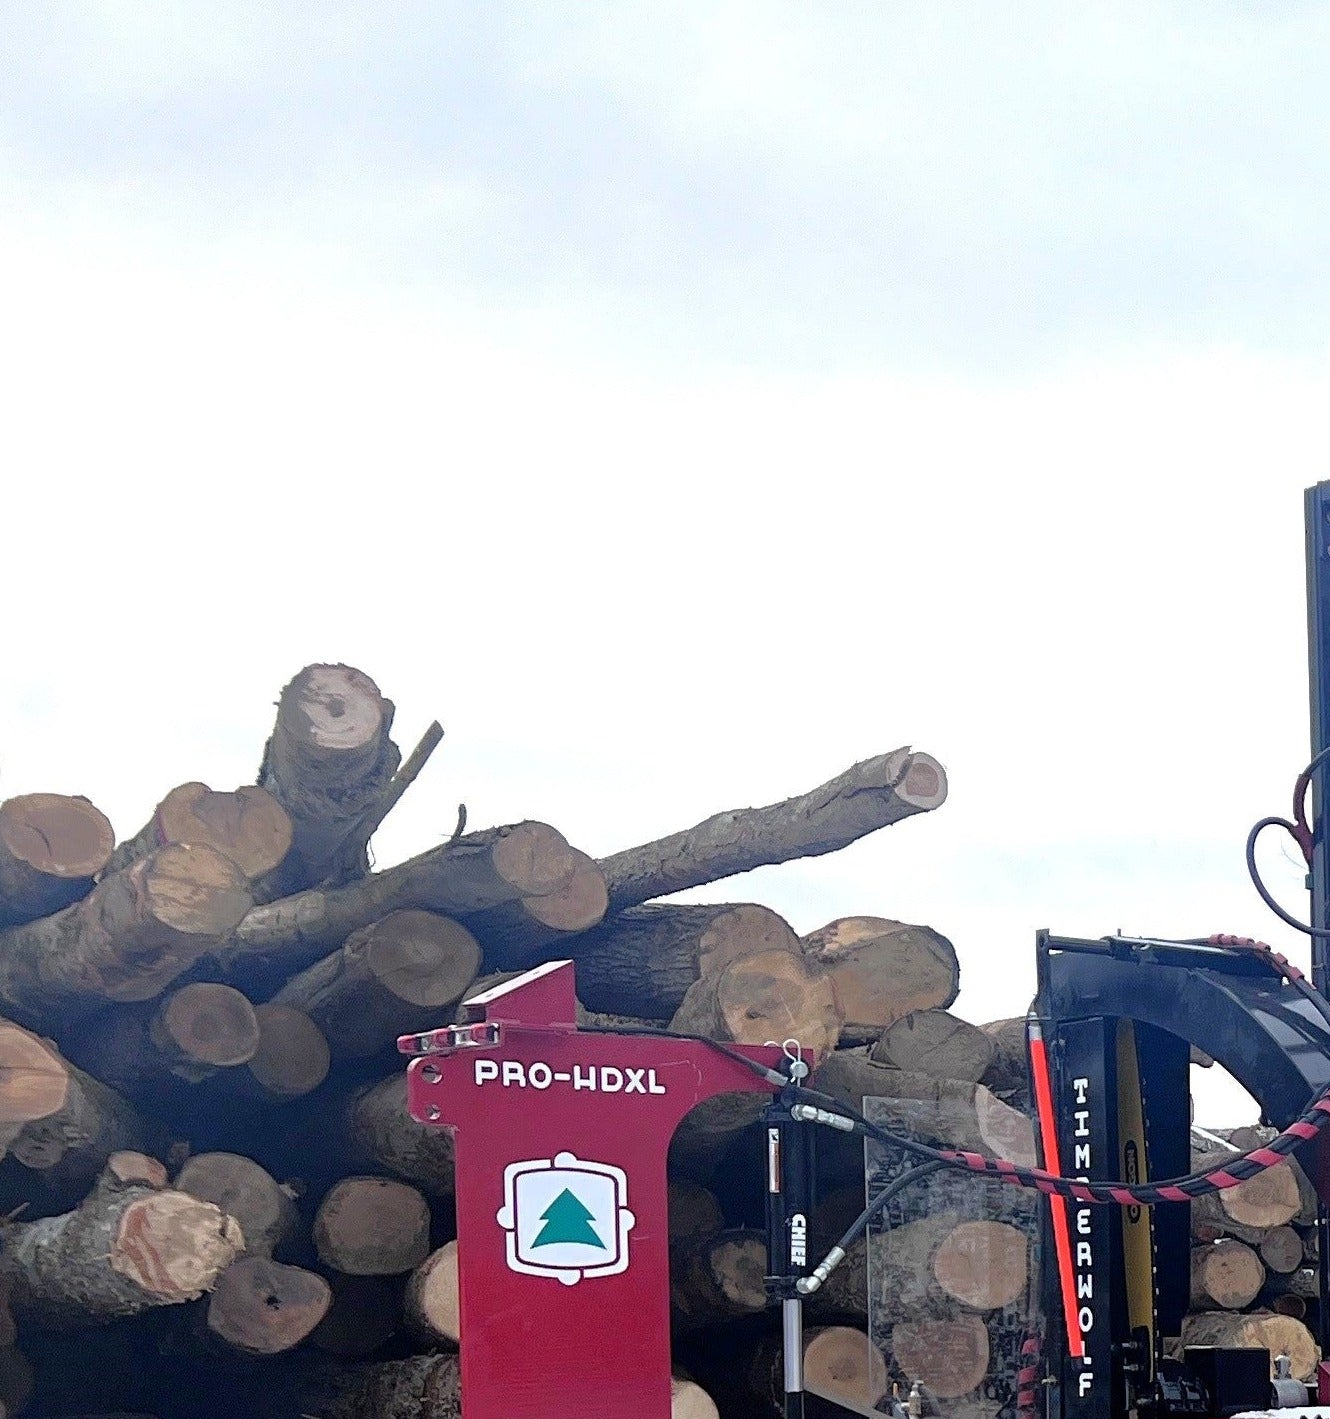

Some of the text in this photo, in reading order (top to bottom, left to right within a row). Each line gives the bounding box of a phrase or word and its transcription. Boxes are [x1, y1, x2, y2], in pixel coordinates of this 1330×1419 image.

[474, 1059, 666, 1095] PRO-HDXL
[791, 1213, 807, 1267] CHIEF
[1073, 1077, 1094, 1397] TIMERWOLF
